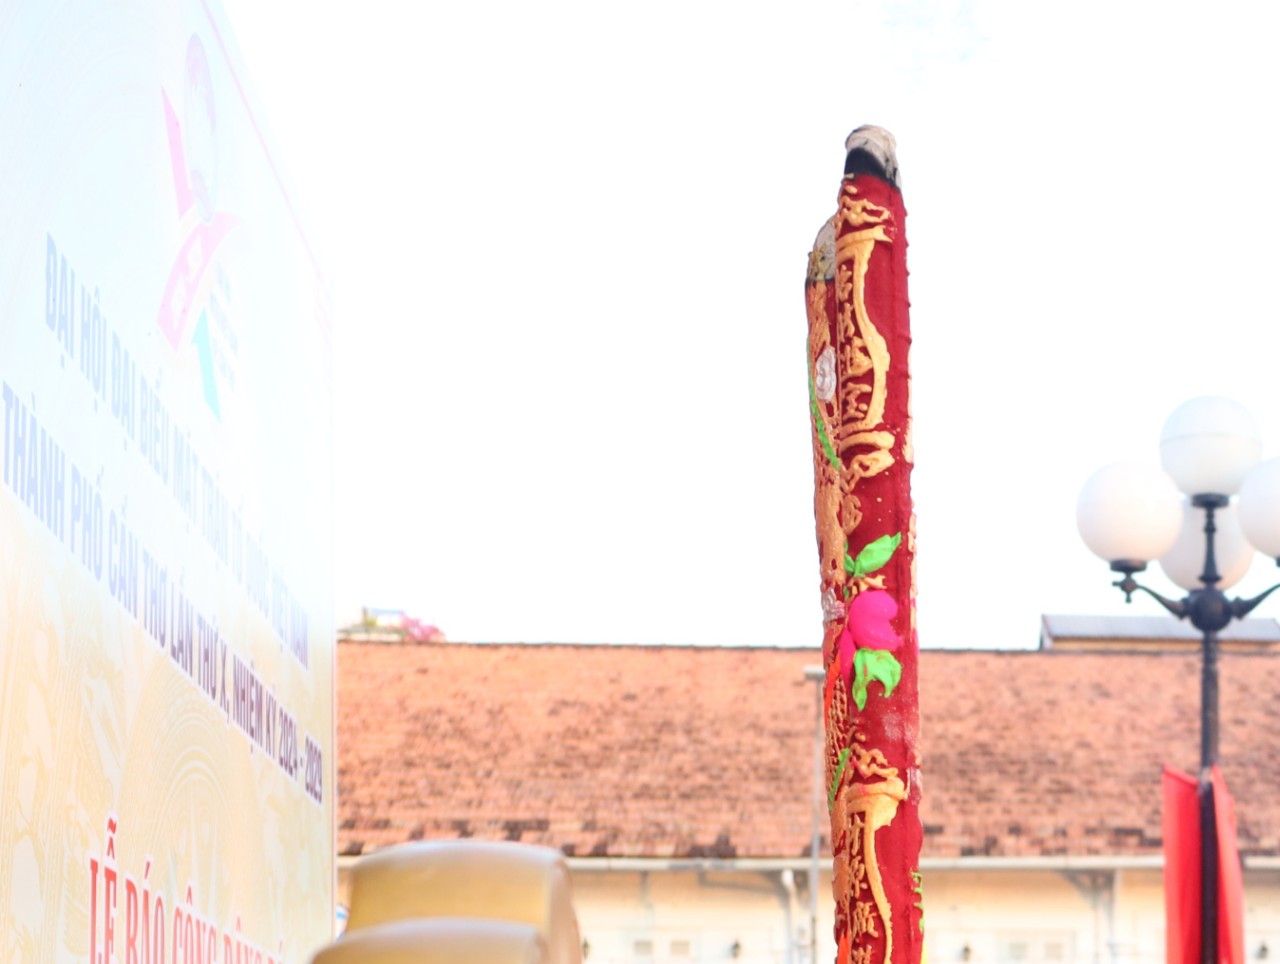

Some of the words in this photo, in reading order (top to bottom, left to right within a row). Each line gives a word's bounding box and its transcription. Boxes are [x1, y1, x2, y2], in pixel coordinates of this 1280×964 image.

[45, 231, 75, 369] ĐẠI
[80, 283, 107, 414] HỘI
[111, 330, 136, 451] ĐẠI
[2, 379, 66, 544] THÀNH
[70, 463, 104, 582] PHỐ
[143, 547, 168, 649] THƠ
[232, 653, 263, 755] NHIỆM
[265, 682, 277, 760] KỲ
[278, 706, 298, 782] 2024
[304, 735, 323, 805] 2029
